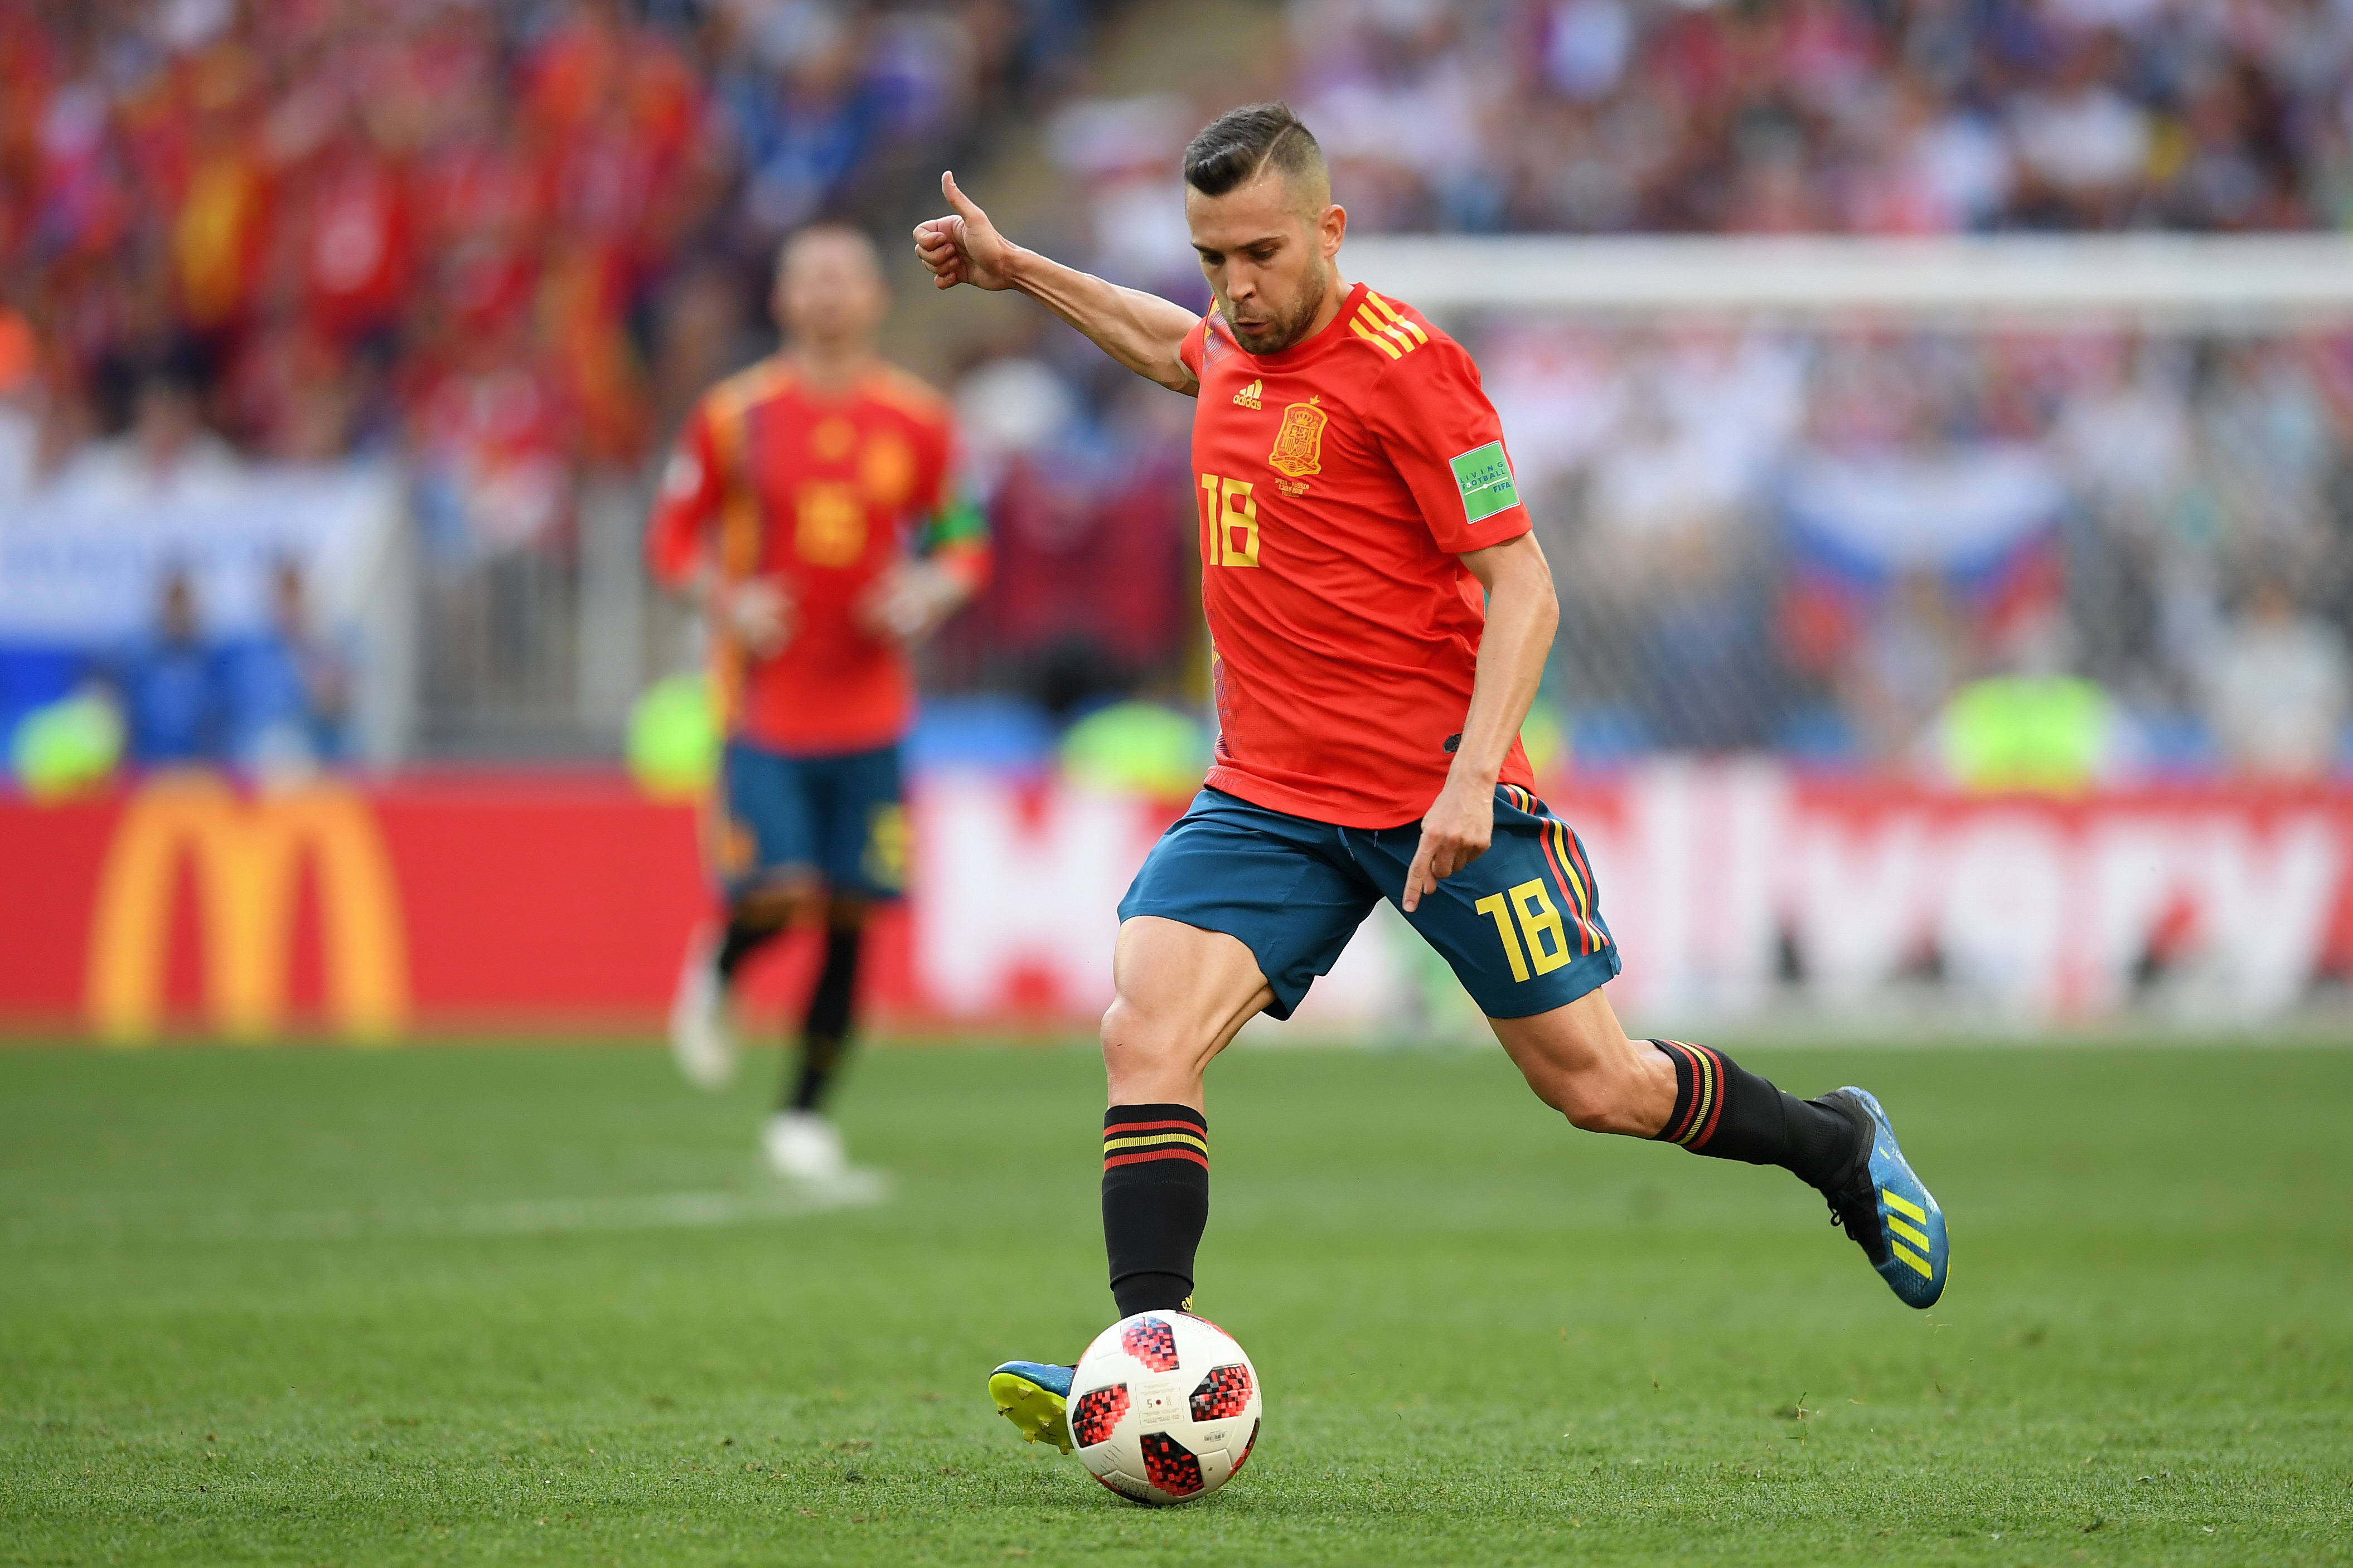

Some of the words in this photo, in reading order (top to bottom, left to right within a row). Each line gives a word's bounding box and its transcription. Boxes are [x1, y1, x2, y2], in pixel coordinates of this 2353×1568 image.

[1233, 394, 1262, 410] adidas
[1460, 461, 1504, 483] LIVING
[1493, 482, 1512, 493] FIFA
[1201, 473, 1261, 568] 18
[1474, 877, 1571, 983] 18
